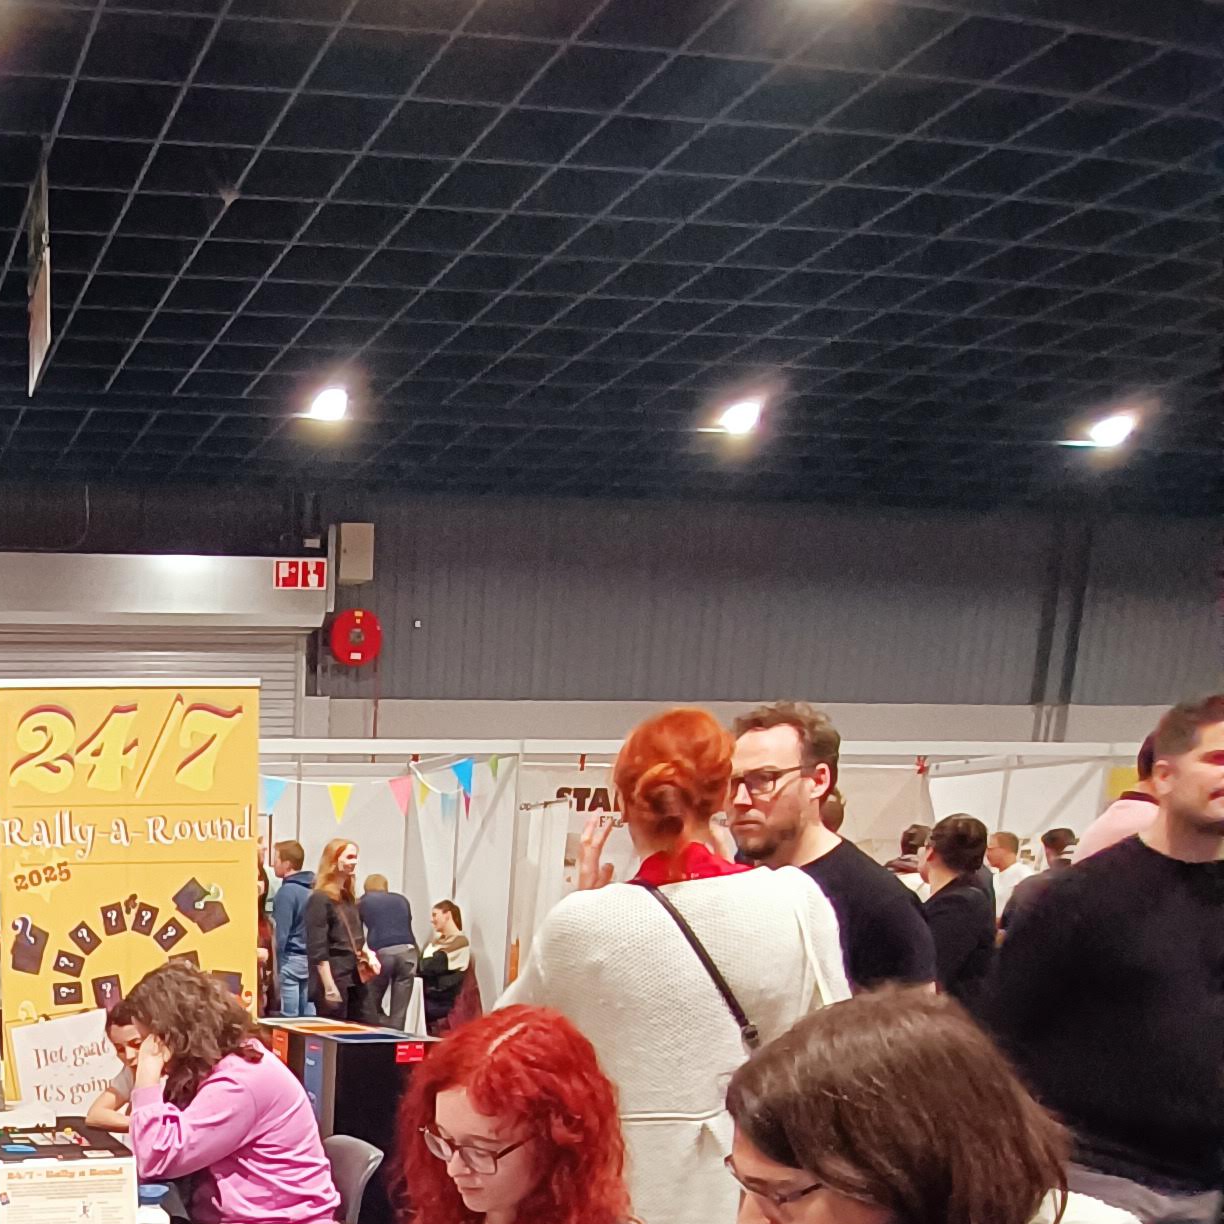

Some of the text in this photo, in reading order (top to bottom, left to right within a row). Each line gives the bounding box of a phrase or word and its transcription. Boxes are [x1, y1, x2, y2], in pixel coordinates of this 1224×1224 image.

[8, 693, 243, 799] 24/7
[556, 786, 622, 812] STA
[2, 803, 254, 859] Rally-a-Round
[14, 861, 72, 892] 2025
[32, 1045, 68, 1070] Het
[69, 1076, 113, 1105] goin
